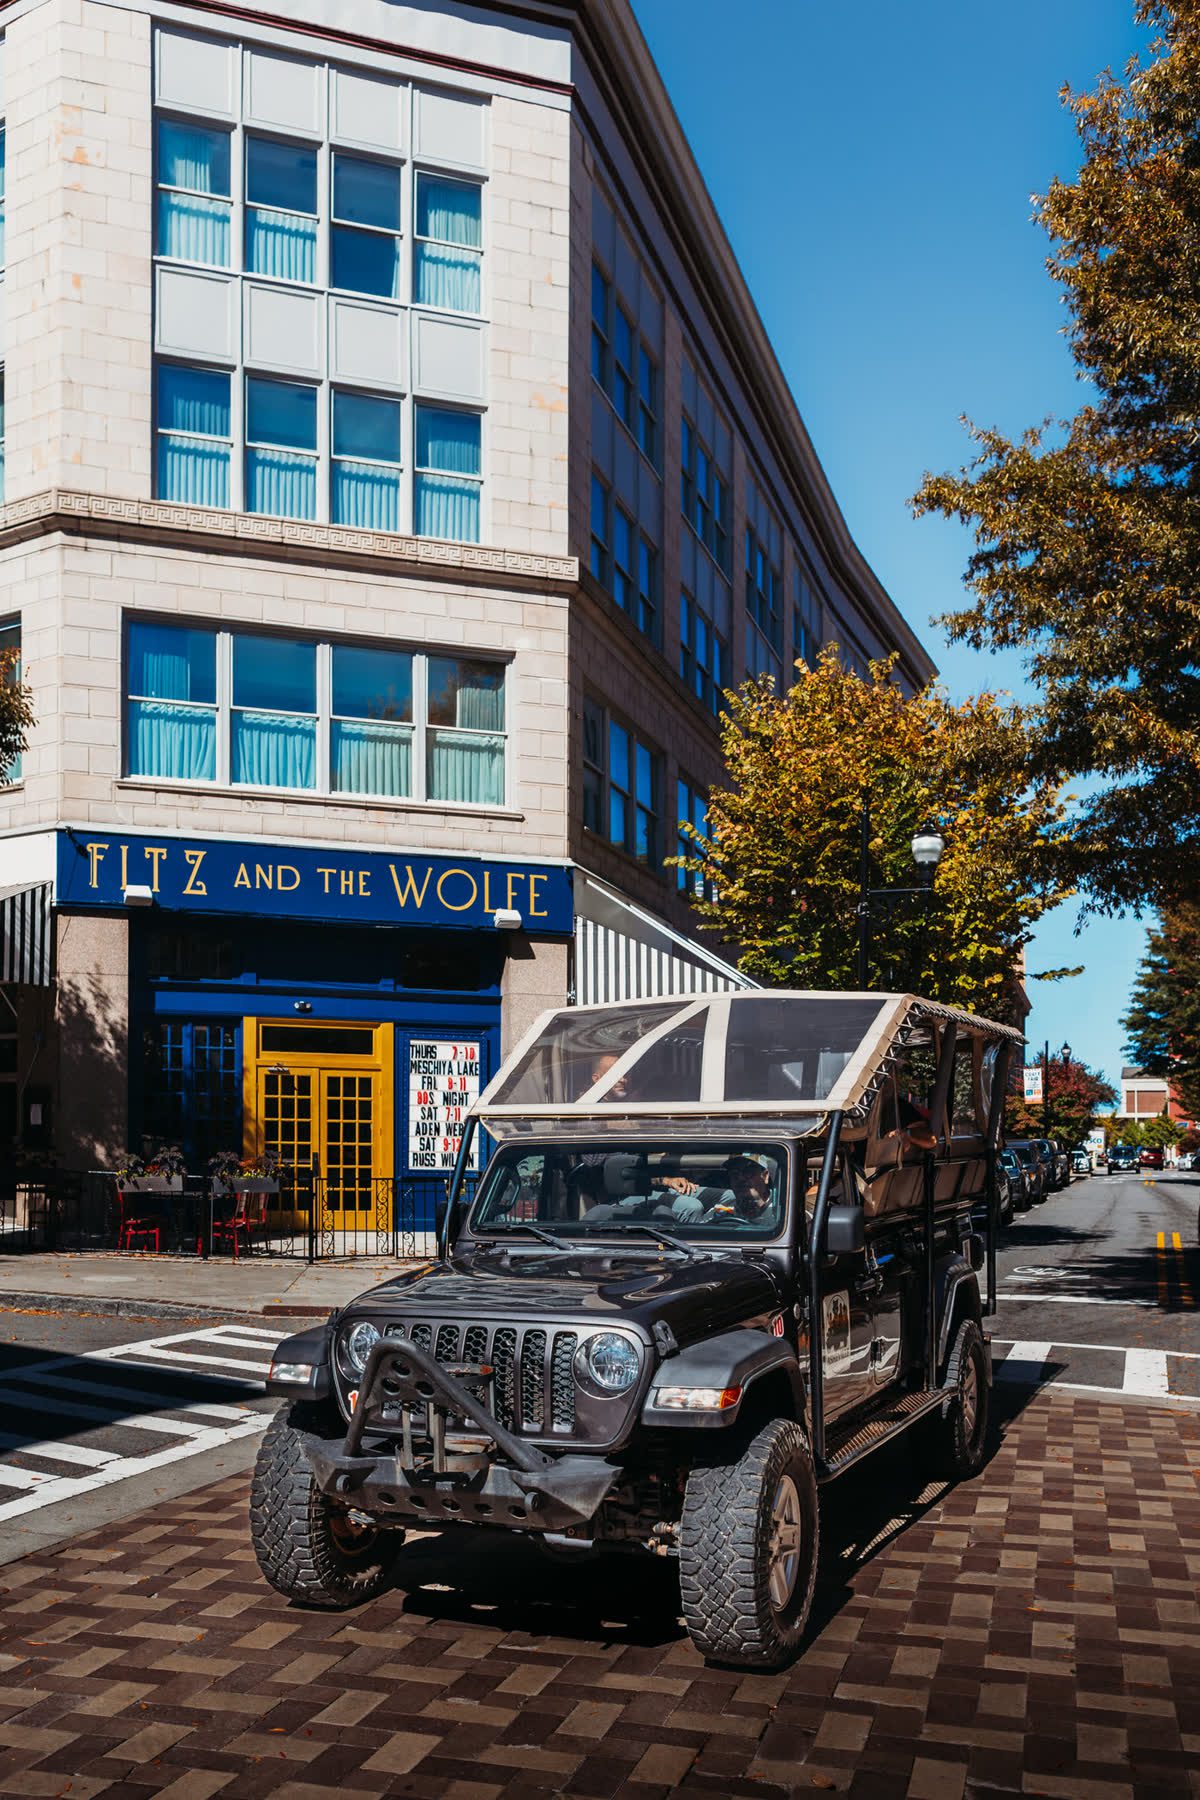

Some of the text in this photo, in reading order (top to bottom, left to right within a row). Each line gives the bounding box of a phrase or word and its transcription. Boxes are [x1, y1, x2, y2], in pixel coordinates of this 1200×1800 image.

[86, 843, 548, 916] FITZ AND THE WOLFE
[410, 1045, 437, 1059] THURS
[410, 1060, 479, 1076] MESCHIYA LAKE
[417, 1091, 469, 1106] 80S NIGHT
[420, 1106, 460, 1121] SAT 7-11
[415, 1121, 464, 1136] ADEN WEB
[419, 1137, 436, 1151] SAT
[412, 1153, 474, 1168] RUSS WILN
[772, 1315, 784, 1337] 10
[348, 1390, 359, 1414] 1
